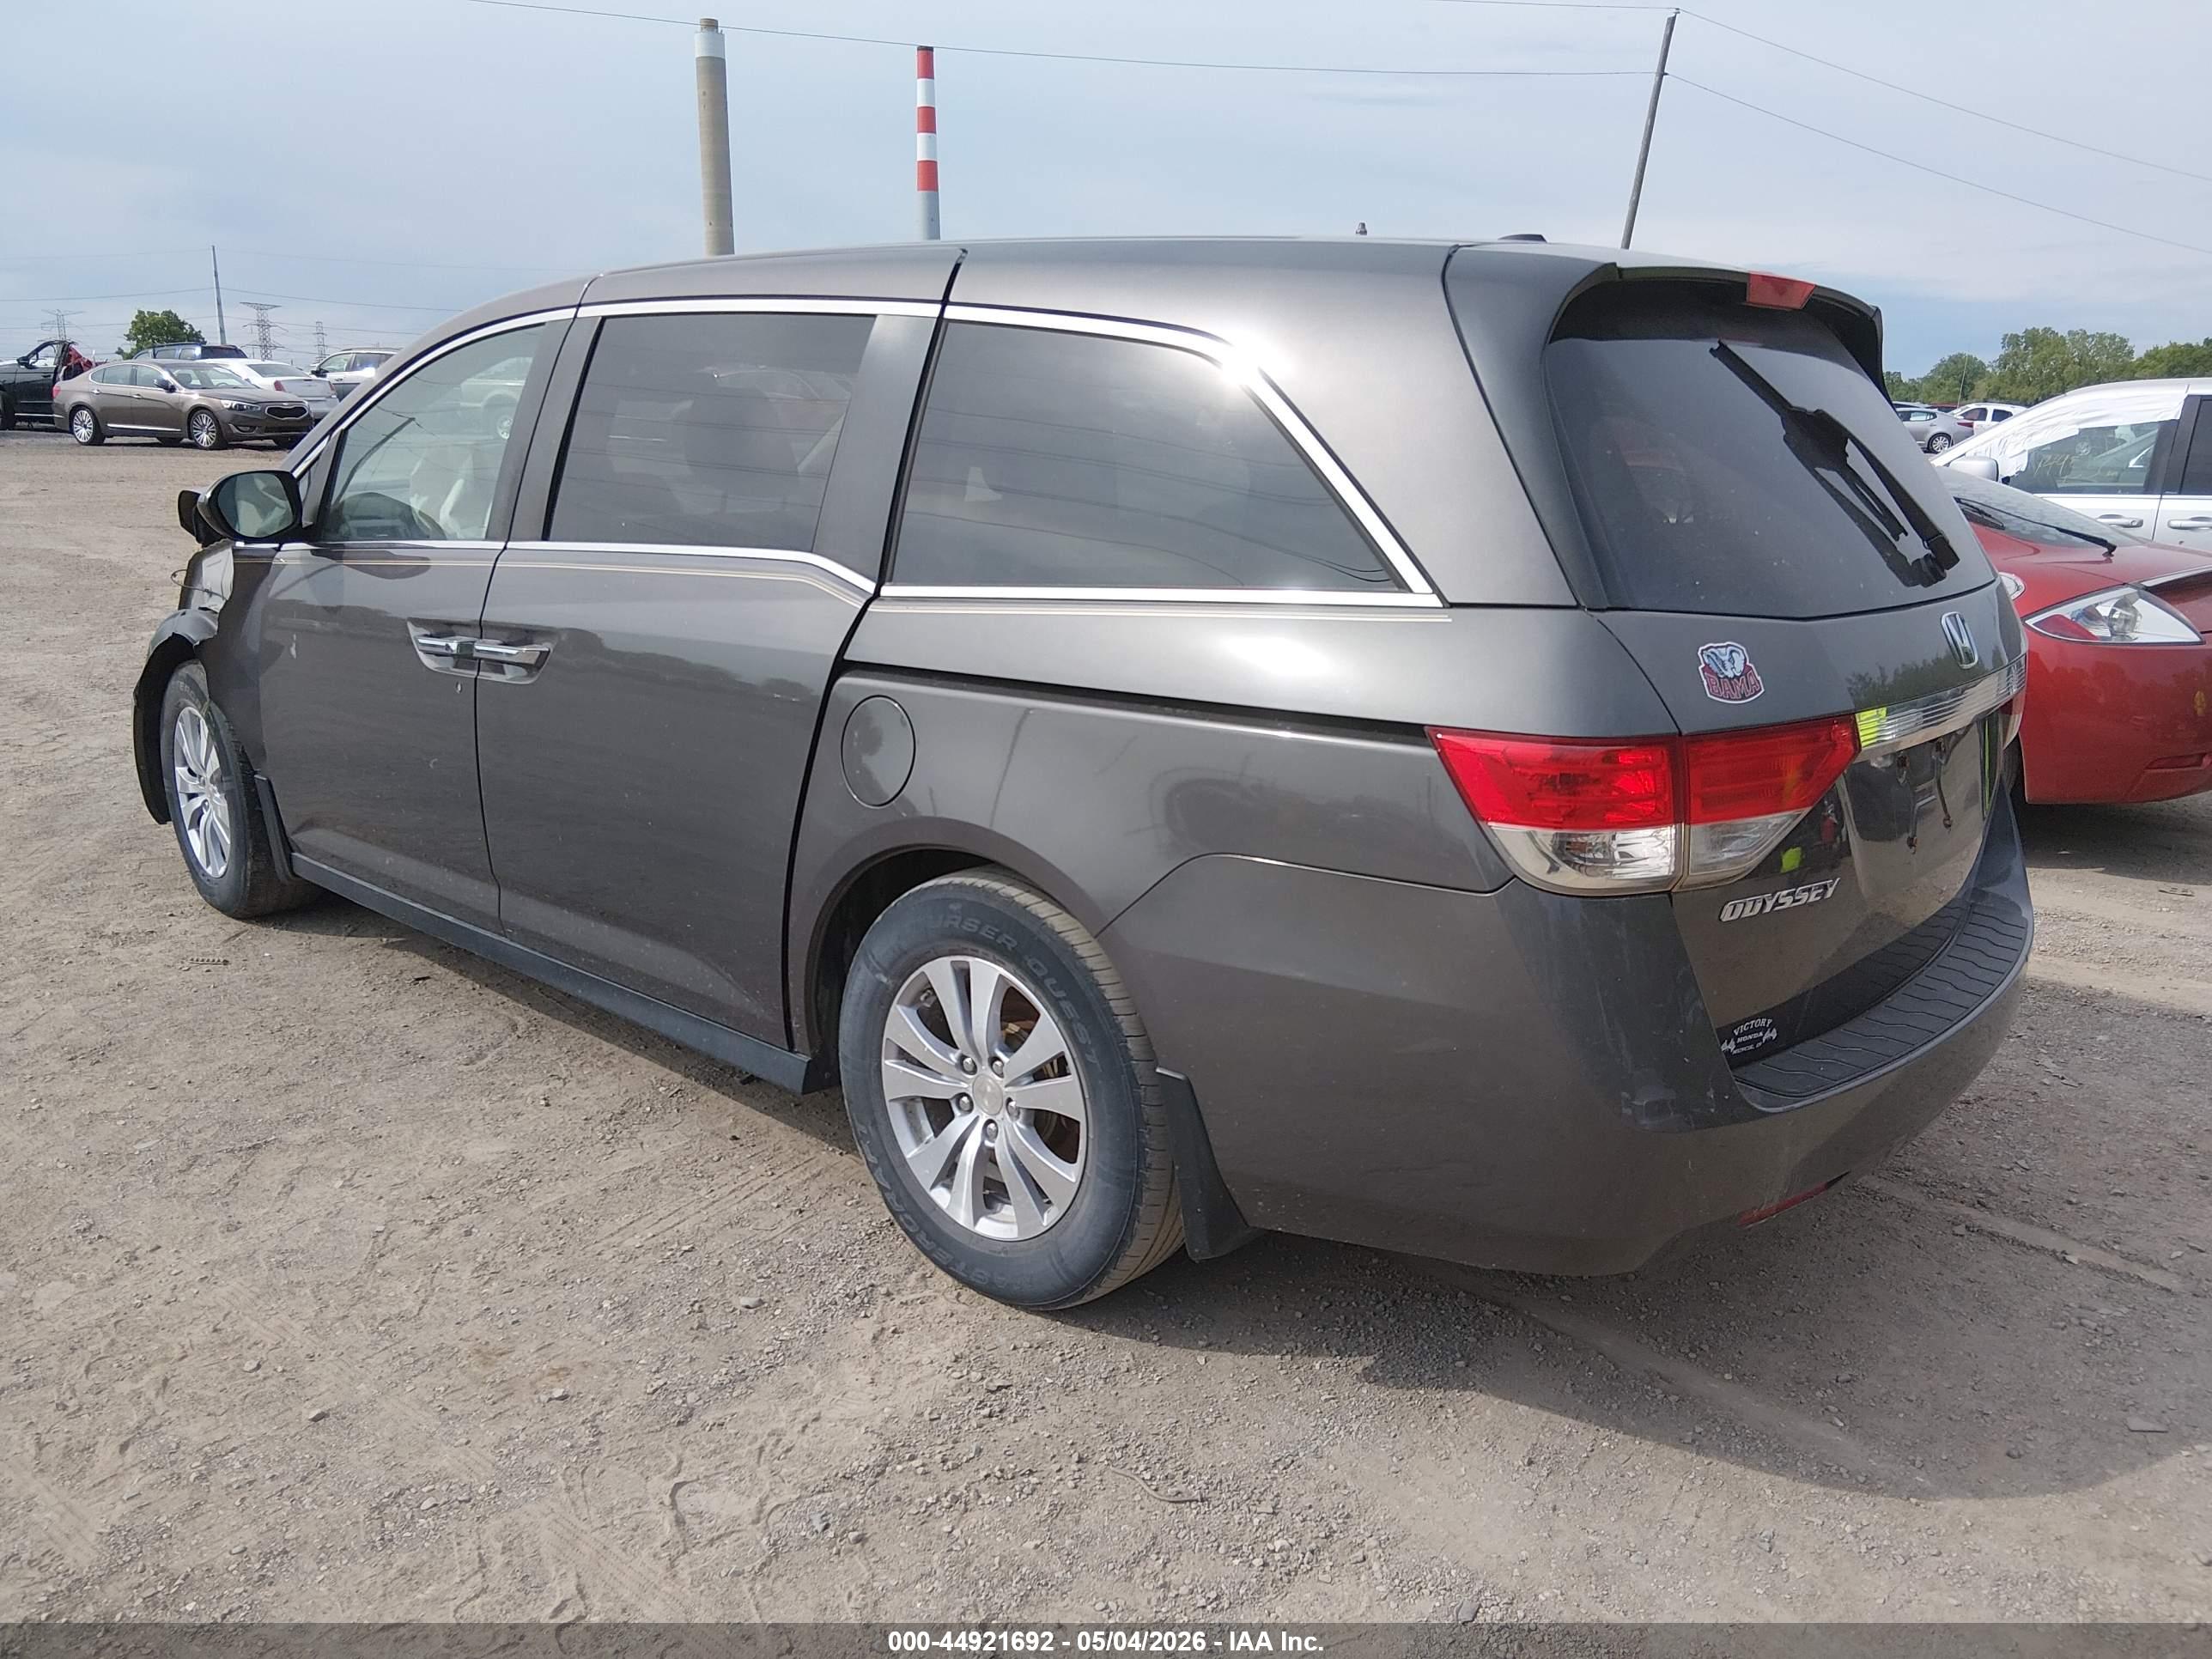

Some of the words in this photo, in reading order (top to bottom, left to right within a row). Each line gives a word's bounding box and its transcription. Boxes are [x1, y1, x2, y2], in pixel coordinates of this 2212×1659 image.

[1705, 671, 1760, 699] BAMA
[1718, 878, 1840, 922] ODYSSEY
[1024, 954, 1100, 1064] QUEST
[1733, 1018, 1773, 1036] VICTORY
[1736, 1031, 1764, 1044] HONDA
